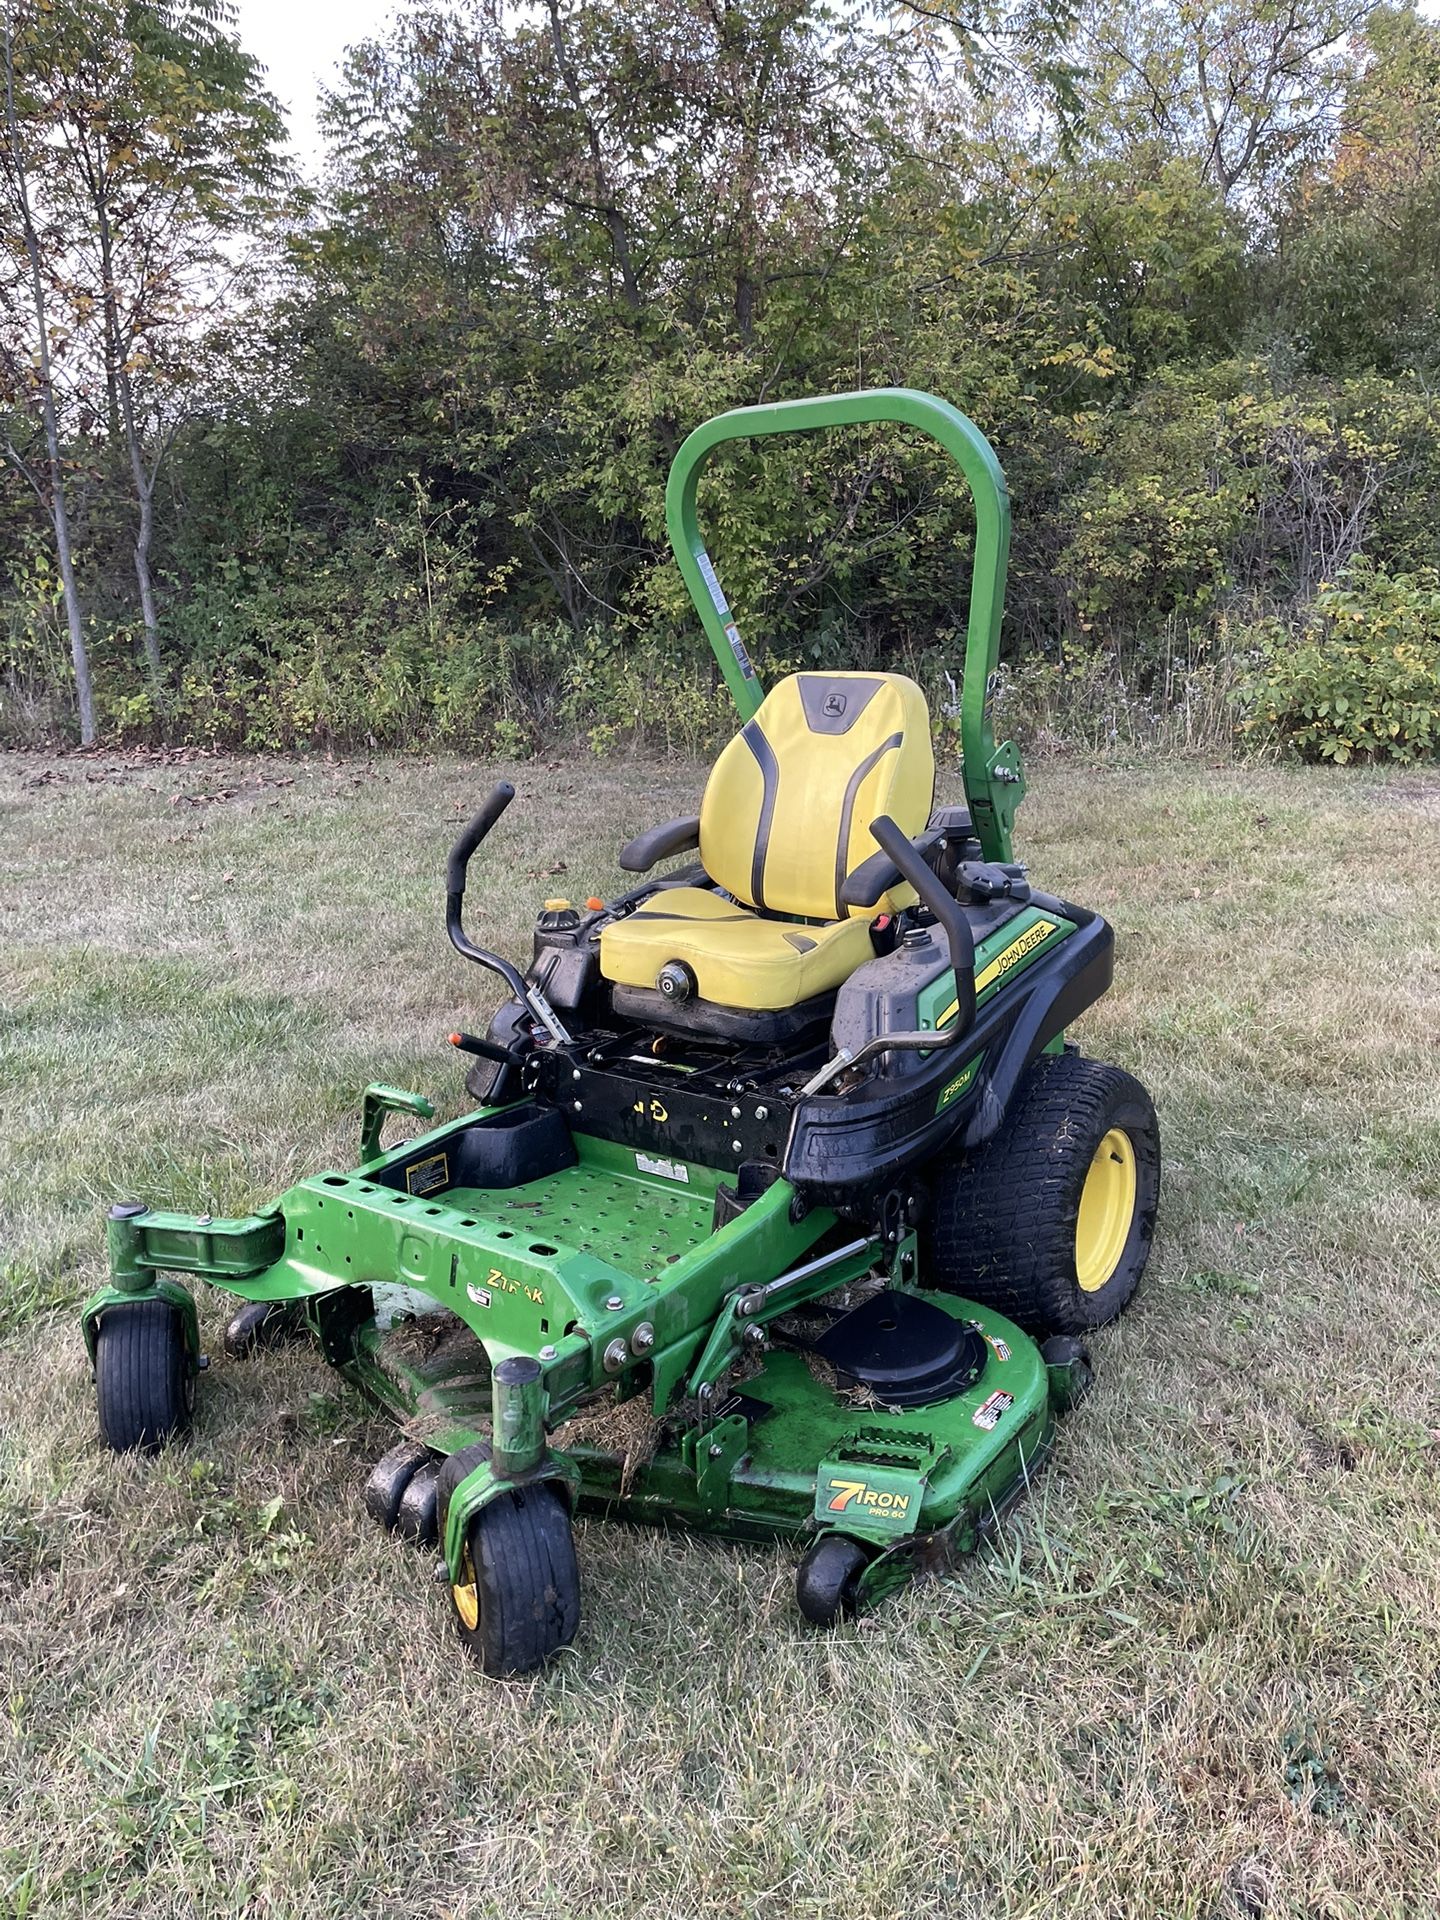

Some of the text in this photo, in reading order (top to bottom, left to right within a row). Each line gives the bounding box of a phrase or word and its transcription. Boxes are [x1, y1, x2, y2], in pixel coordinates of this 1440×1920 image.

[997, 925, 1047, 974] JOHN DEERE
[828, 1479, 910, 1512] 7 IRON
[868, 1507, 906, 1519] PRO 60
